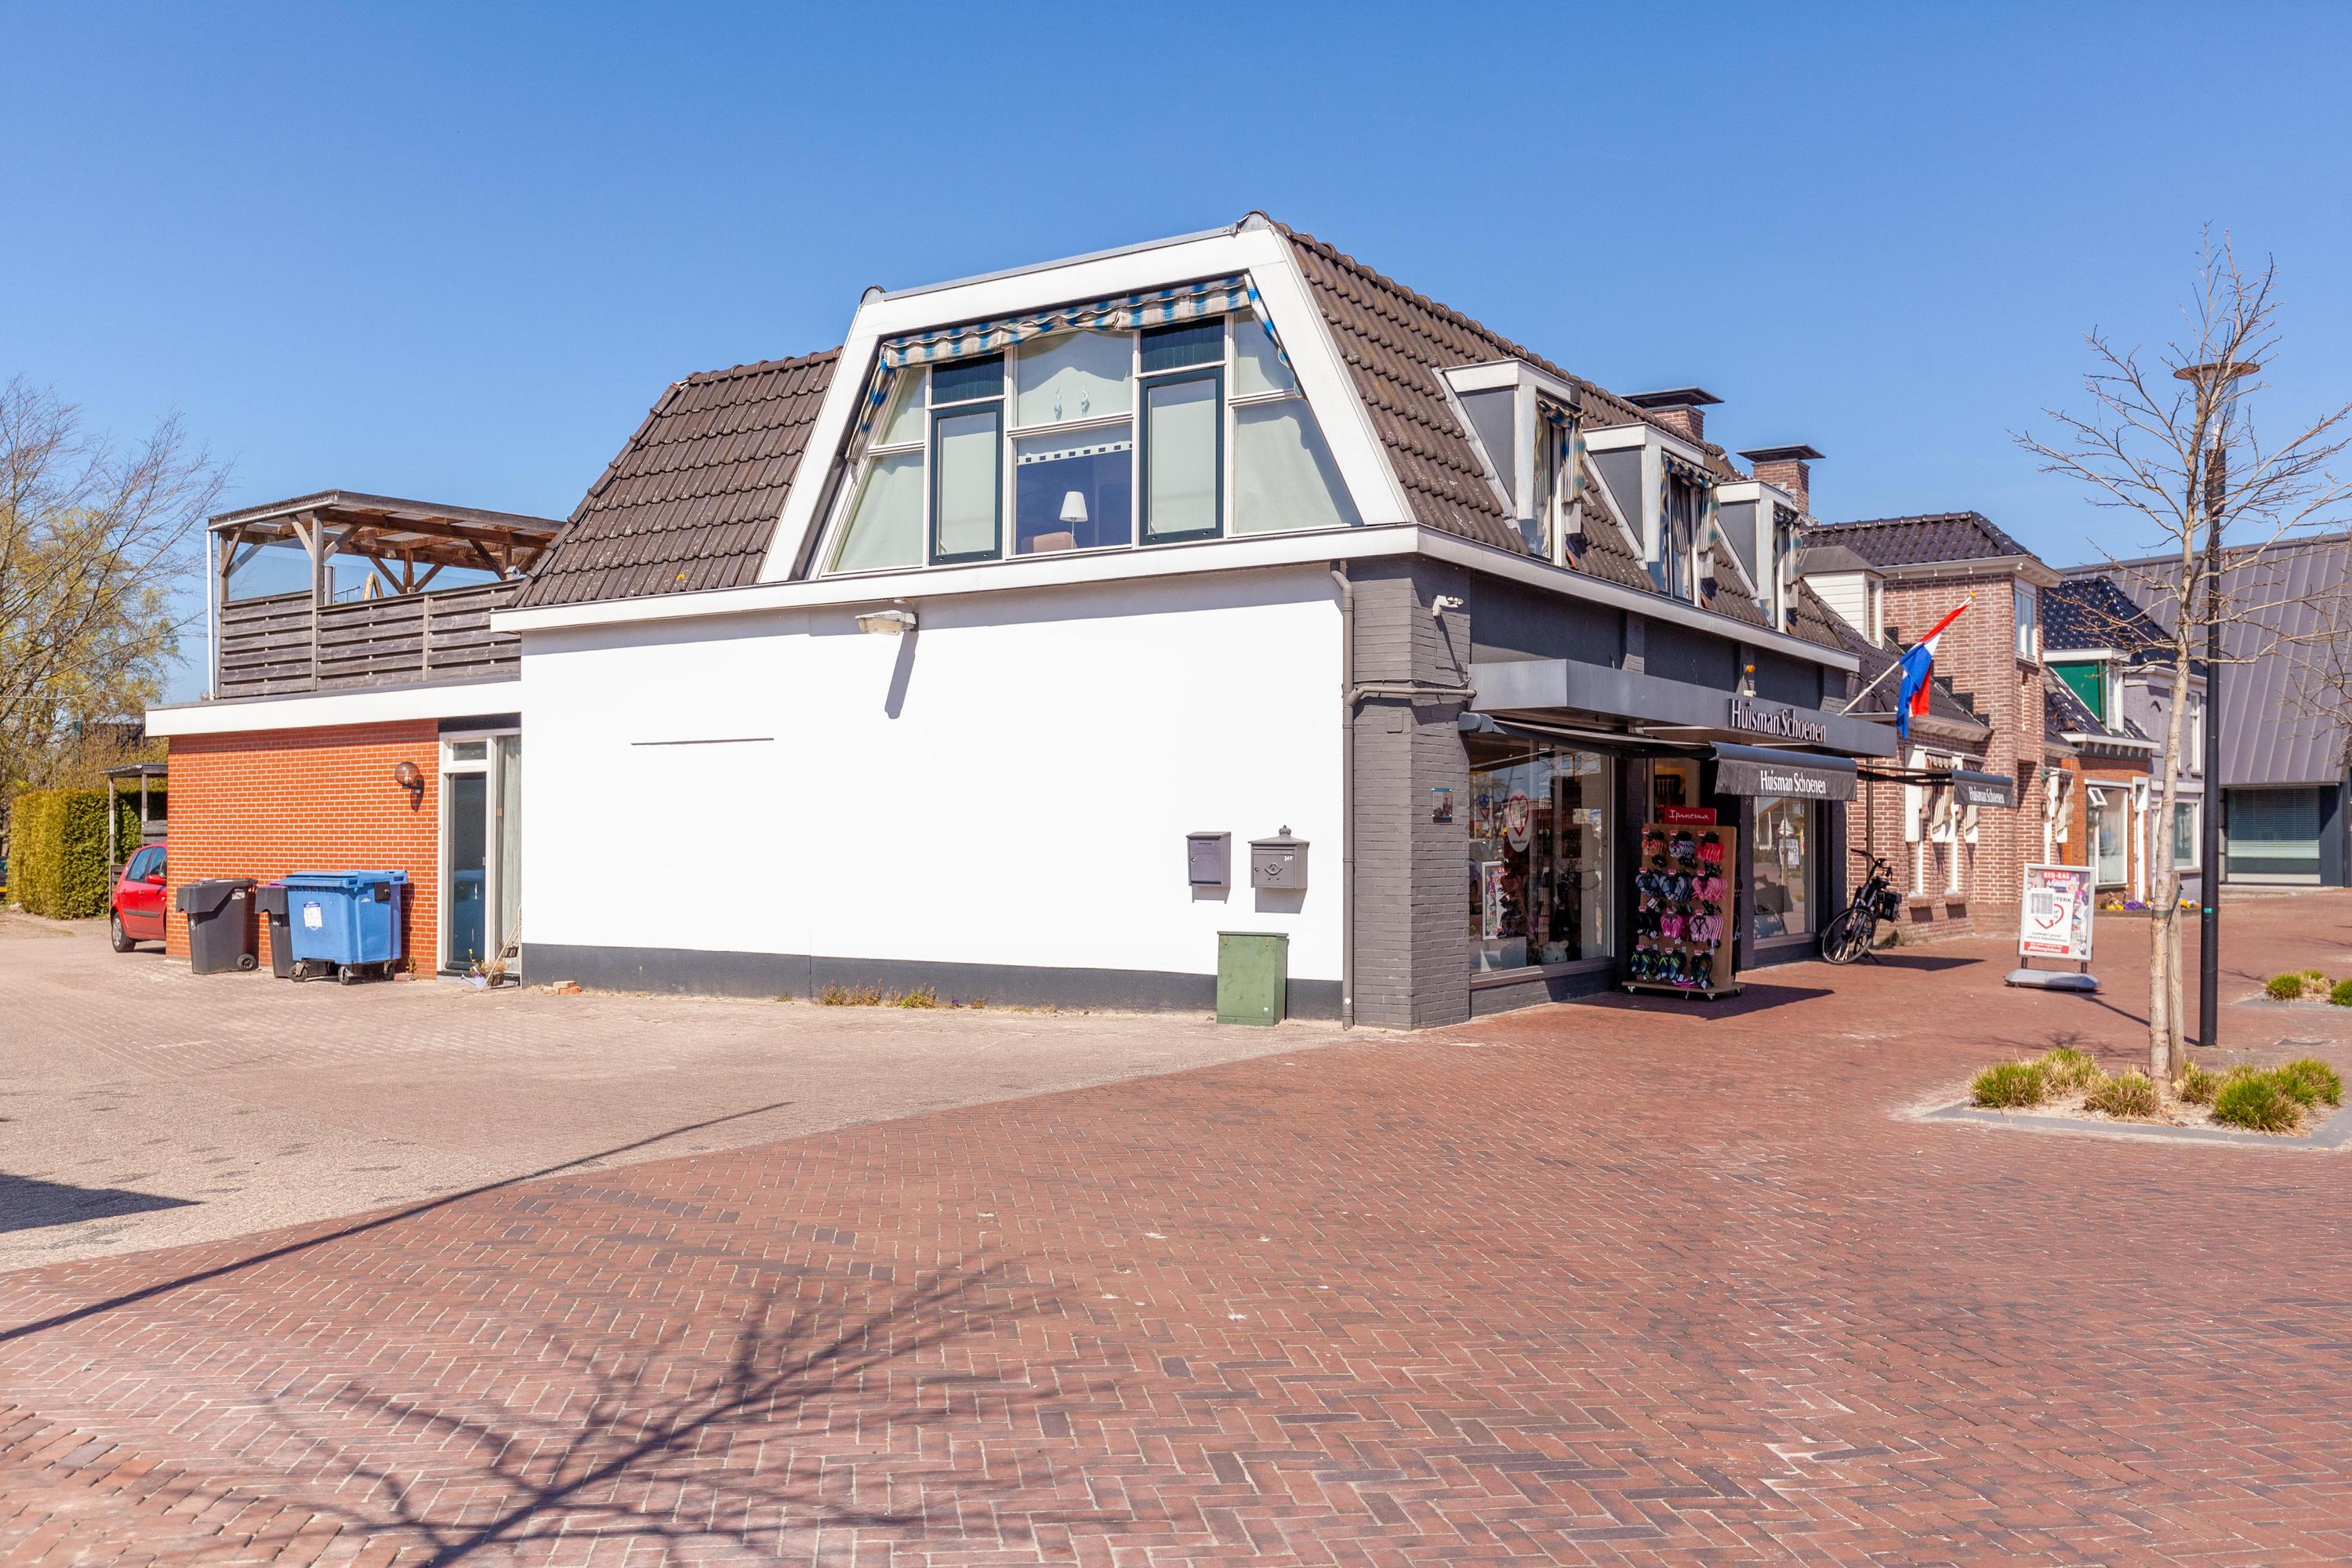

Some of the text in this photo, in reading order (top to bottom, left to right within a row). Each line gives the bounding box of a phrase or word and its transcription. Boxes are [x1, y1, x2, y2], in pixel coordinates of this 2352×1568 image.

[1730, 698, 1827, 742] Huisman Schoenen
[1760, 769, 1827, 794] Huisman Schoenen
[1668, 809, 1710, 822] Ipanema
